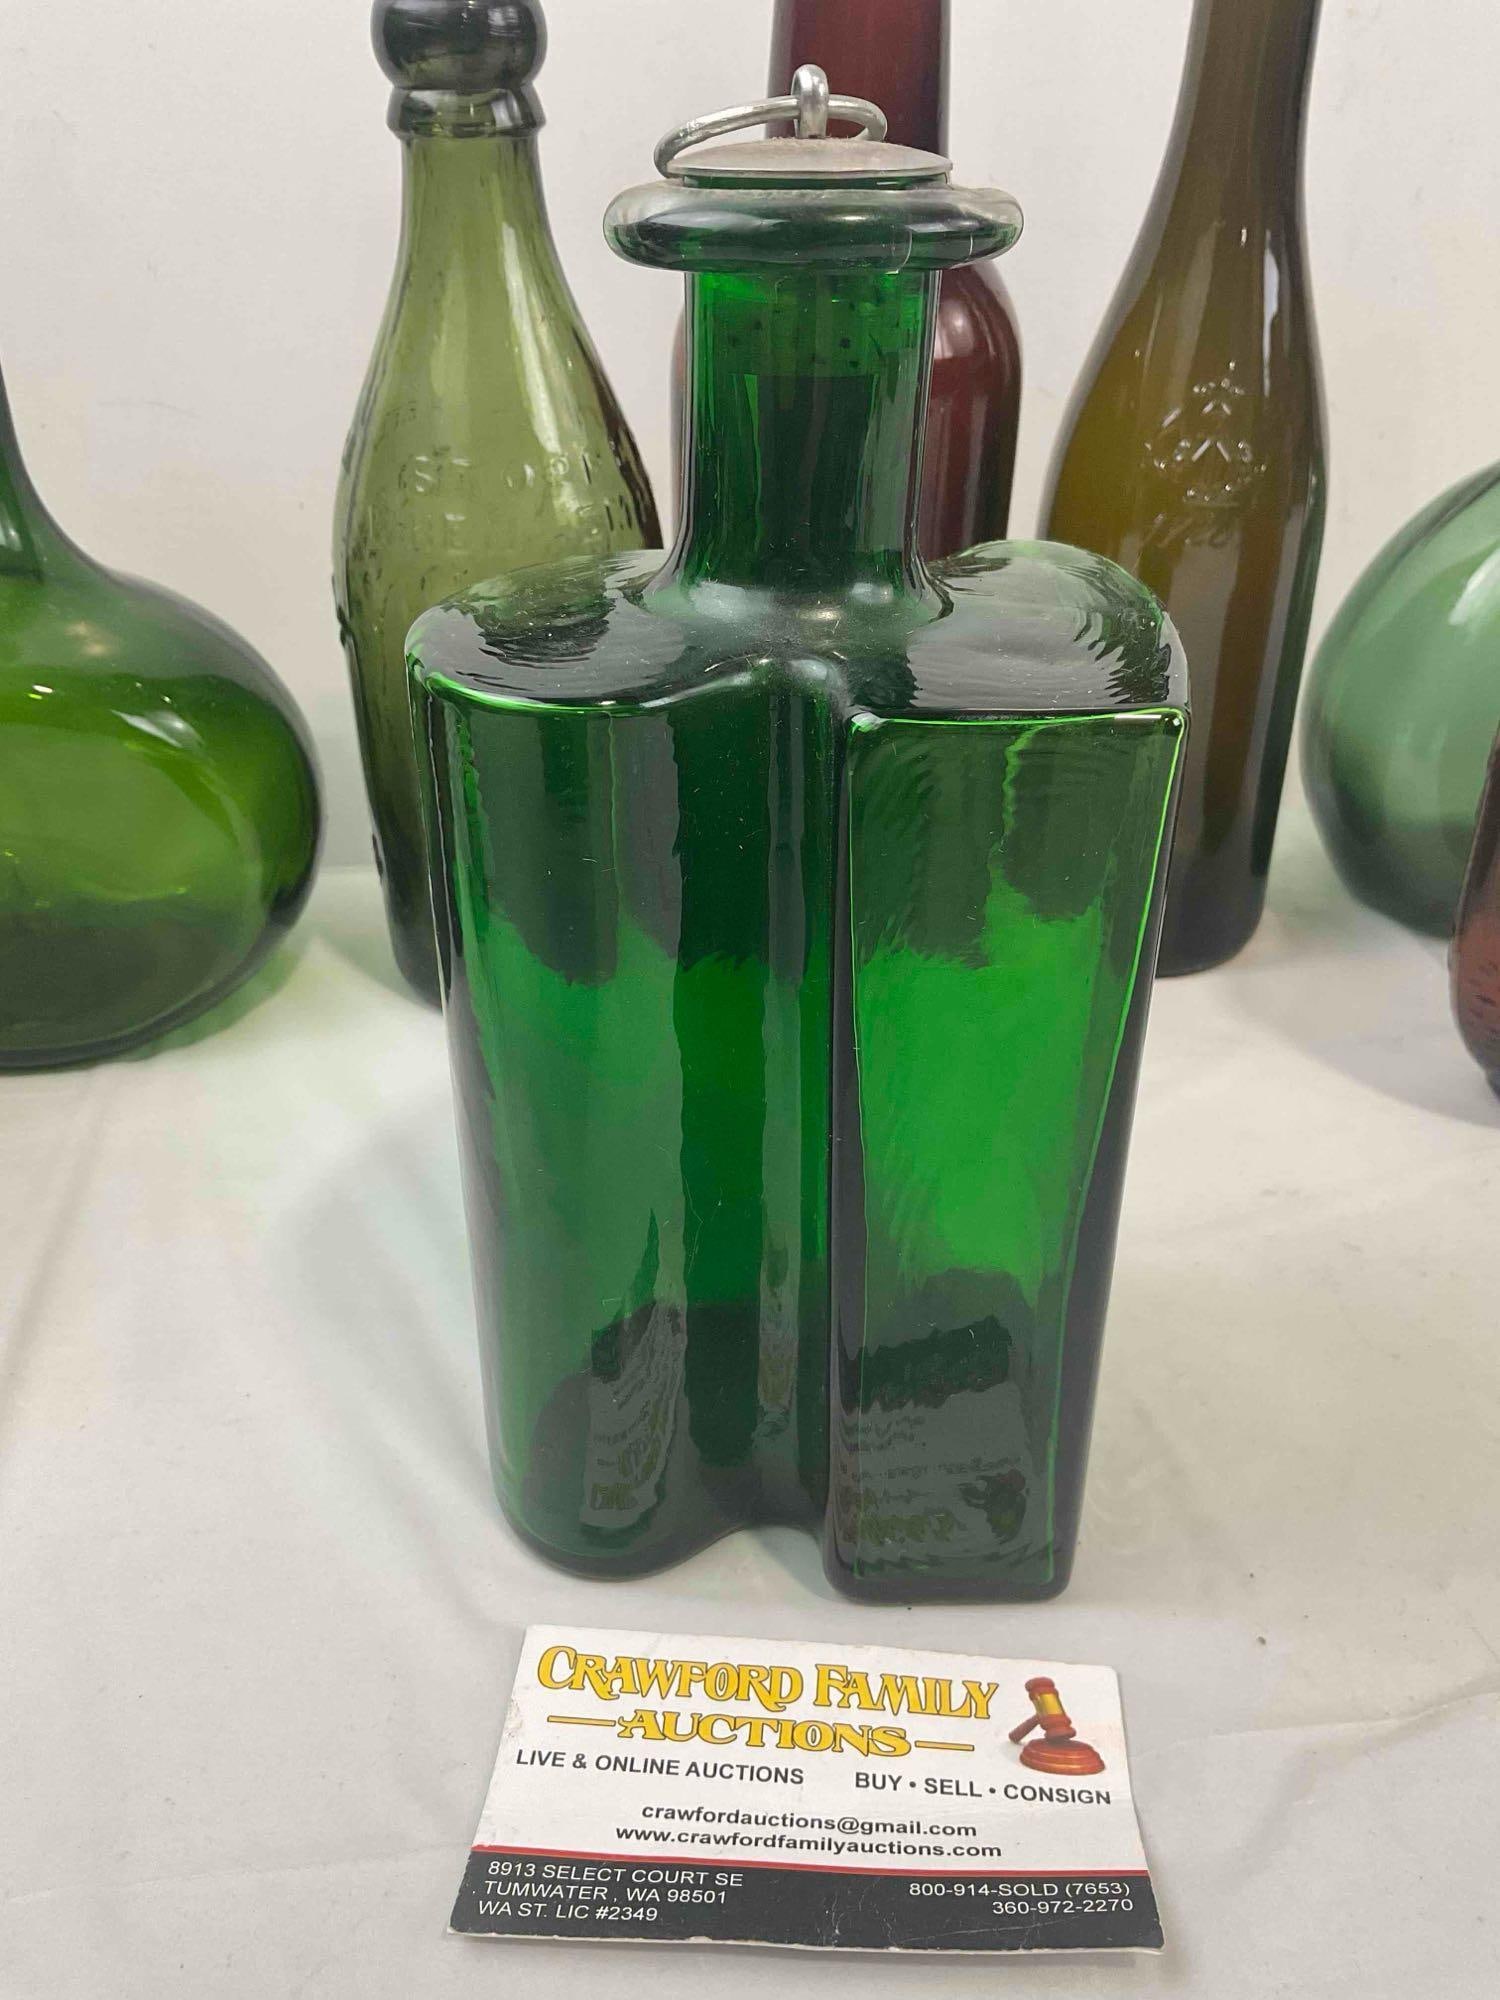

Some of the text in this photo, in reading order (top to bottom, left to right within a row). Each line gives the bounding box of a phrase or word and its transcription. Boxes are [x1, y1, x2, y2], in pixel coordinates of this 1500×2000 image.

[537, 1645, 999, 1719] CRAWFORD FAMILY
[617, 1708, 912, 1757] AUCTIONS
[516, 1749, 804, 1784] LIVE & ONLINE AUCTIONS
[855, 1772, 1112, 1804] BUY SELL CONSIGN
[641, 1805, 977, 1836] crawfordauctions@gmail.com
[615, 1827, 1002, 1857] www.crawfordfamilyauctions.com
[488, 1861, 744, 1887] 8913 SELECT COURT SE
[626, 1887, 660, 1901] WA
[667, 1889, 727, 1904] 98501
[909, 1882, 1130, 1897] 800-914-SOLD (7653)
[478, 1900, 658, 1921] WA ST. LIC #2349
[992, 1898, 1134, 1915] 360-972-2270
